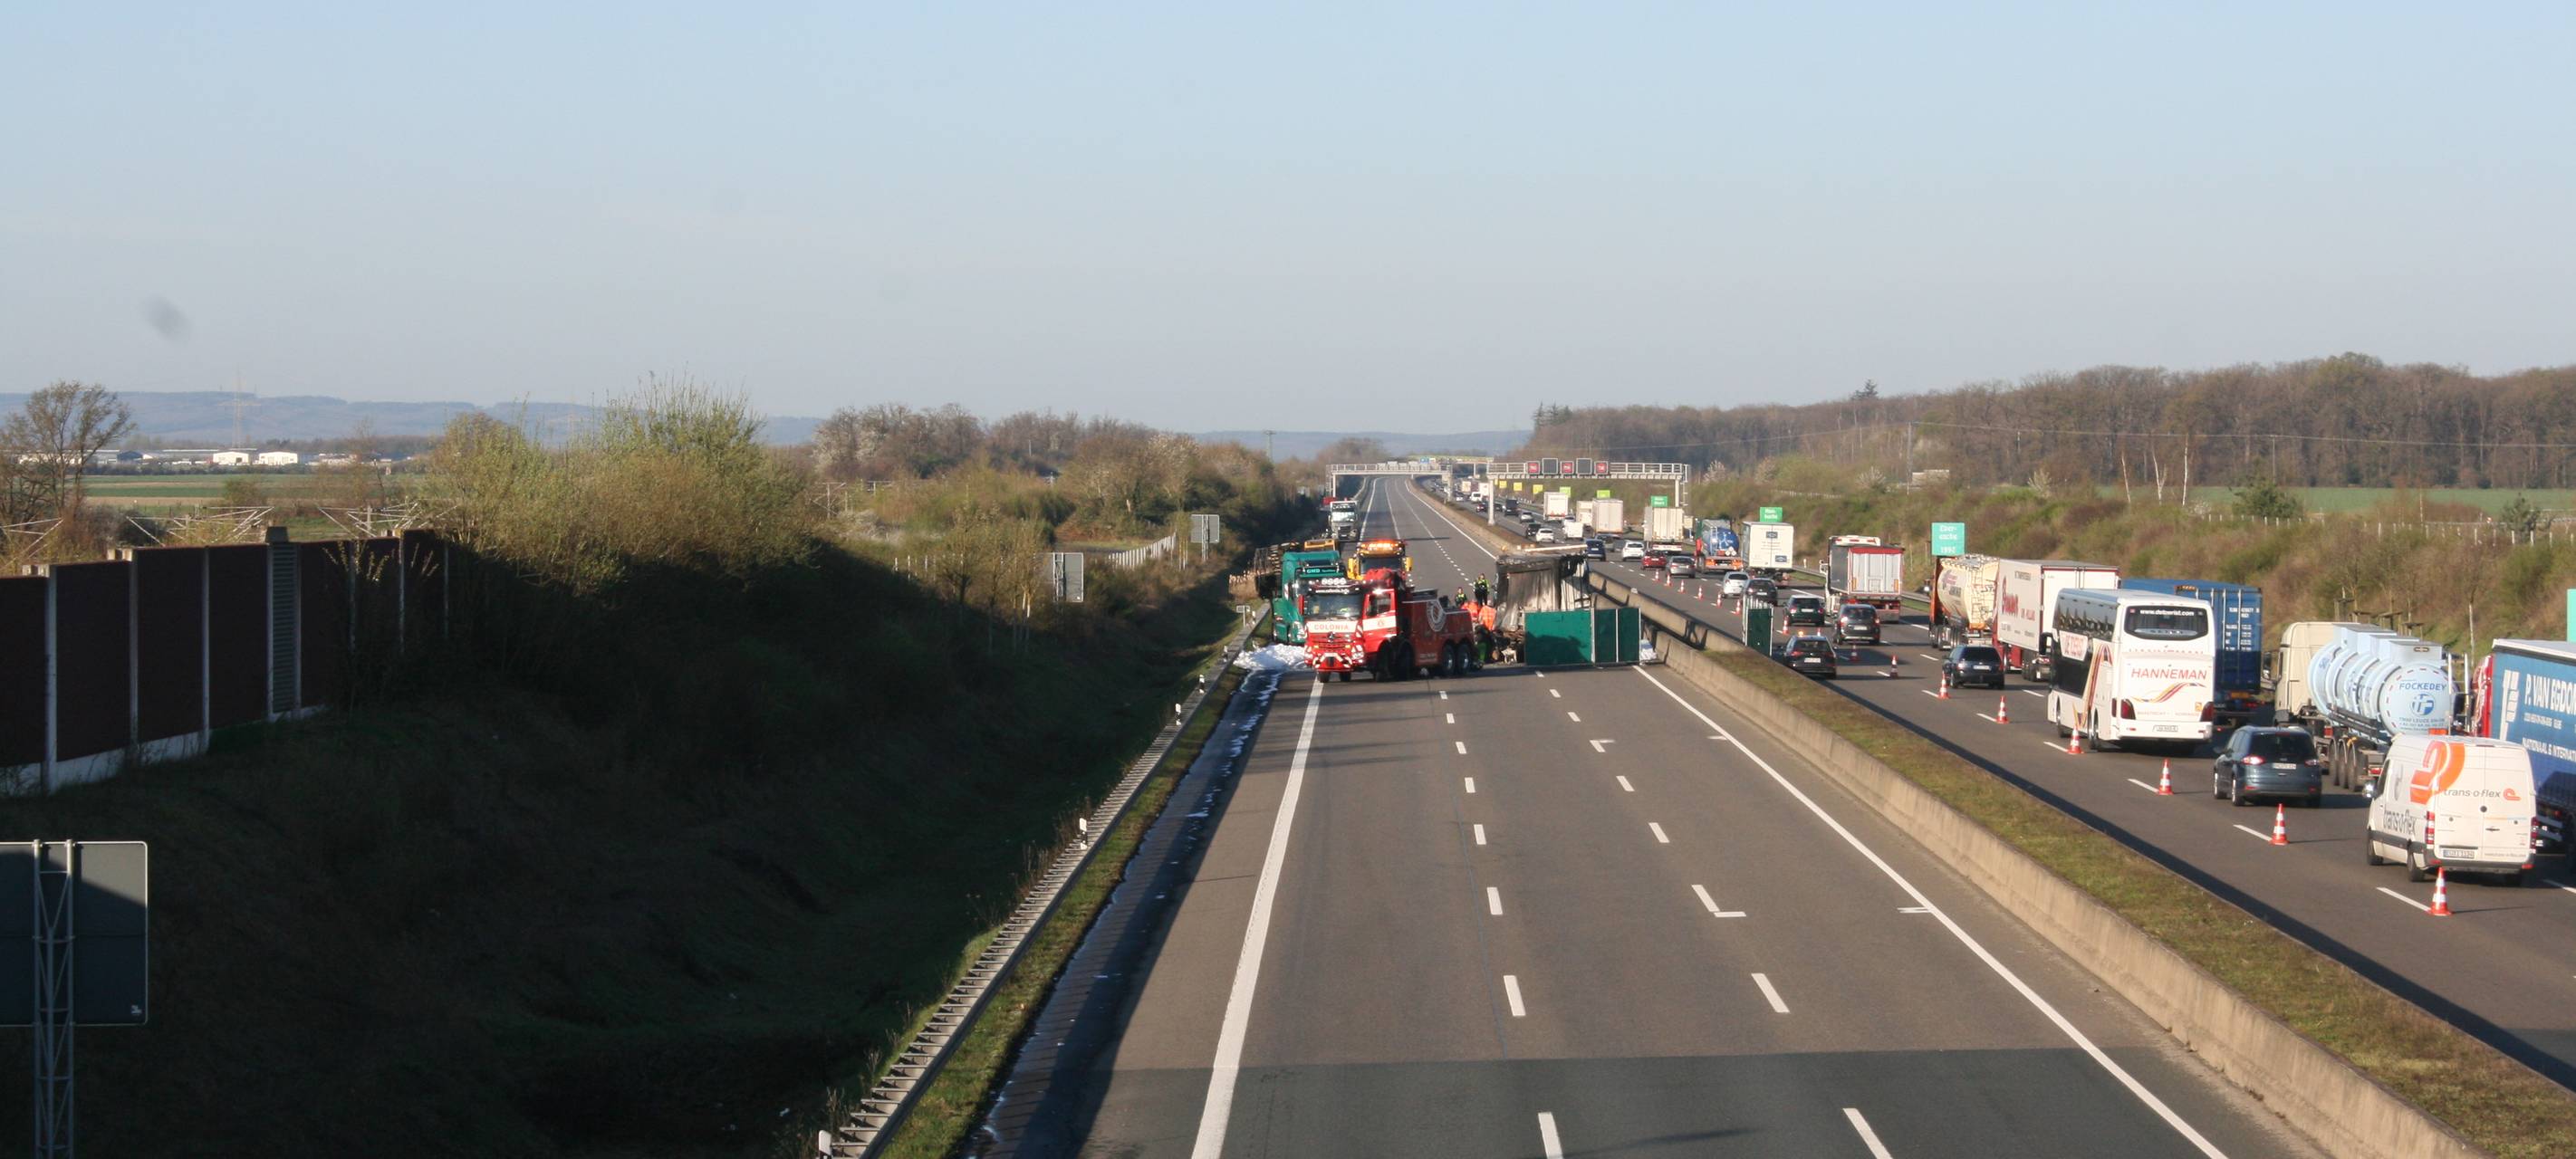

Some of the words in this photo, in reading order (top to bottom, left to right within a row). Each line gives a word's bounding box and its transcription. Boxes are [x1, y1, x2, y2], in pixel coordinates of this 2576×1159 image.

[2131, 668, 2207, 679] HANNEMAN
[2399, 683, 2446, 691] FOCKEDEY
[2524, 673, 2532, 705] P.
[2533, 675, 2551, 709] VAN
